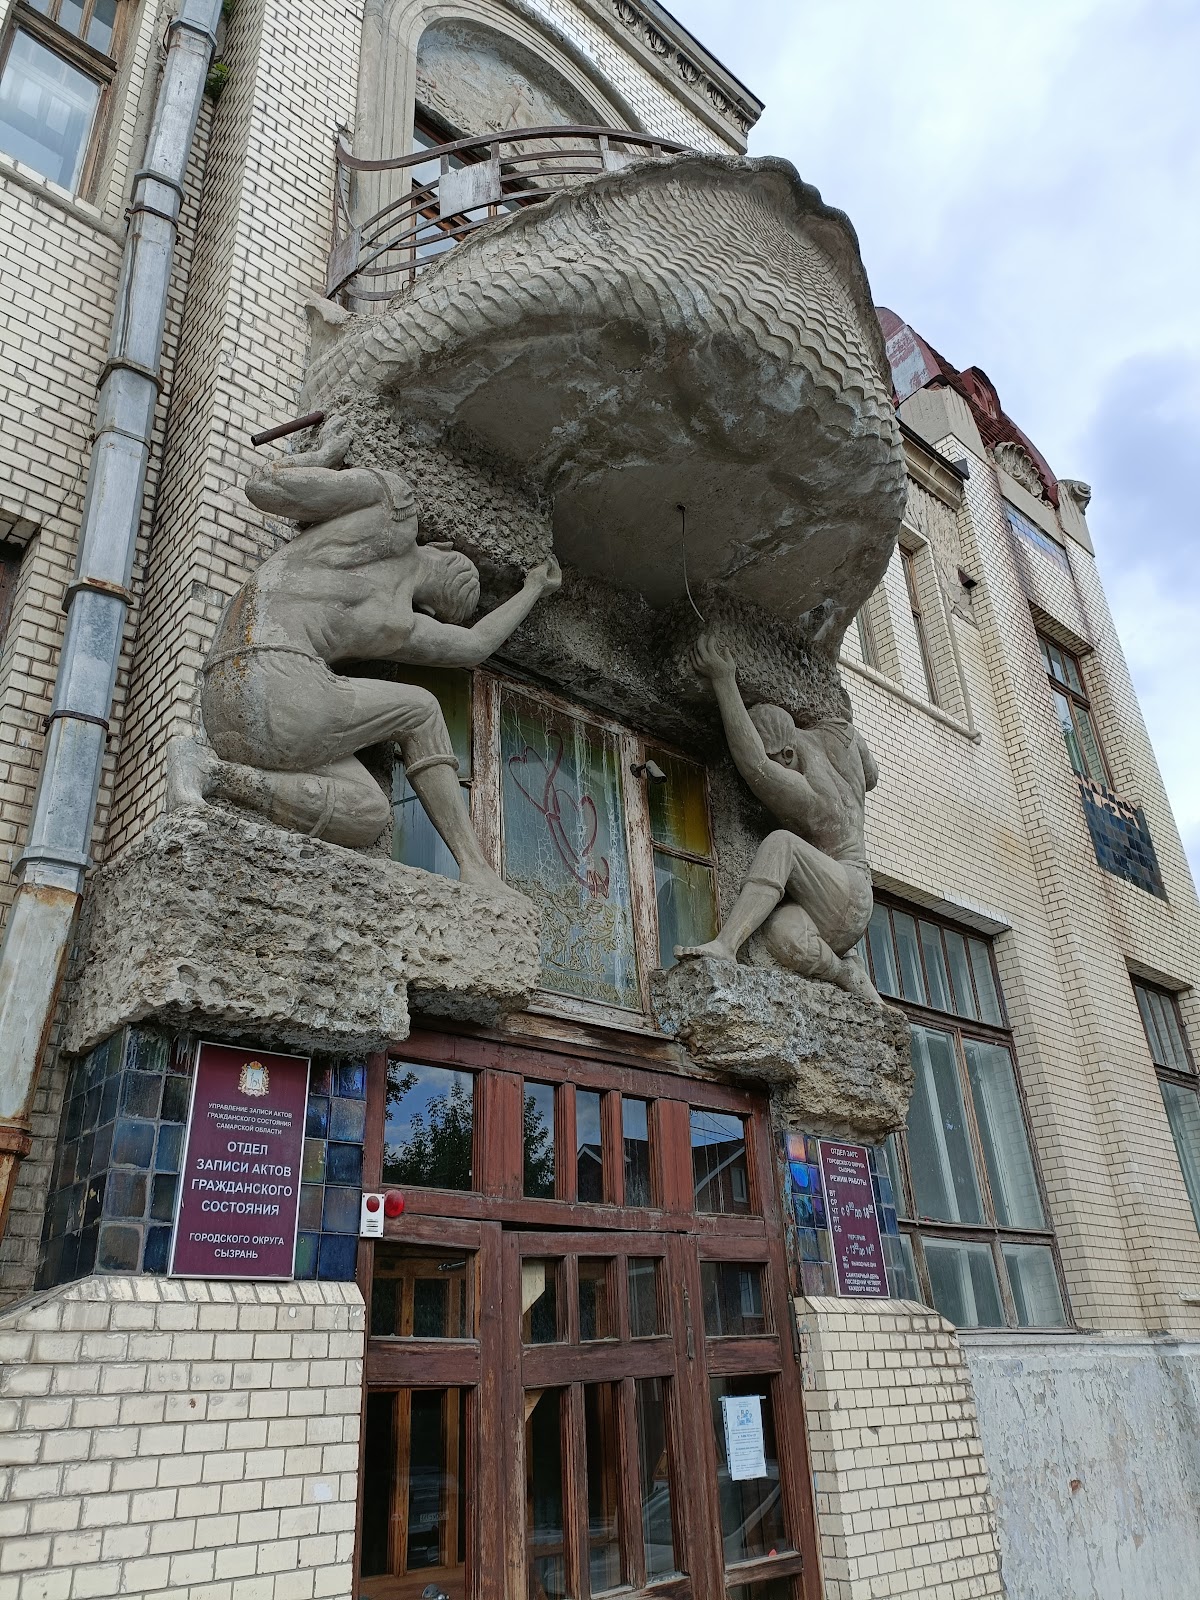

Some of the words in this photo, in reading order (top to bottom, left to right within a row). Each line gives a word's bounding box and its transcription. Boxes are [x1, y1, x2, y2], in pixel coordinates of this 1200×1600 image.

[208, 1103, 248, 1113] УПРАВЛЕНИЕ
[250, 1108, 272, 1116] ЗАПИСИ
[274, 1110, 292, 1118] АКТОВ
[207, 1112, 256, 1123] ГРАЖДАНСКОГО
[257, 1118, 292, 1127] СОСТОЯНИЯ
[216, 1122, 254, 1132] САМАРСКОЙ
[255, 1127, 282, 1135] ОБЛАСТИ
[227, 1141, 268, 1156] ОТДЕЛ
[830, 1148, 846, 1156] ОТДЕЛ
[196, 1158, 248, 1174] ЗАПИСИ
[252, 1164, 292, 1177] АКТОВ
[192, 1178, 292, 1197] ГРАЖДАНСКОГО
[848, 1177, 867, 1186] РАБОТЫ
[202, 1200, 280, 1216] СОСТОЯНИЯ
[190, 1232, 250, 1244] ГОРОДСКОГО
[252, 1236, 284, 1246] ОКРУГА
[214, 1248, 258, 1259] СЫЗРАНЬ
